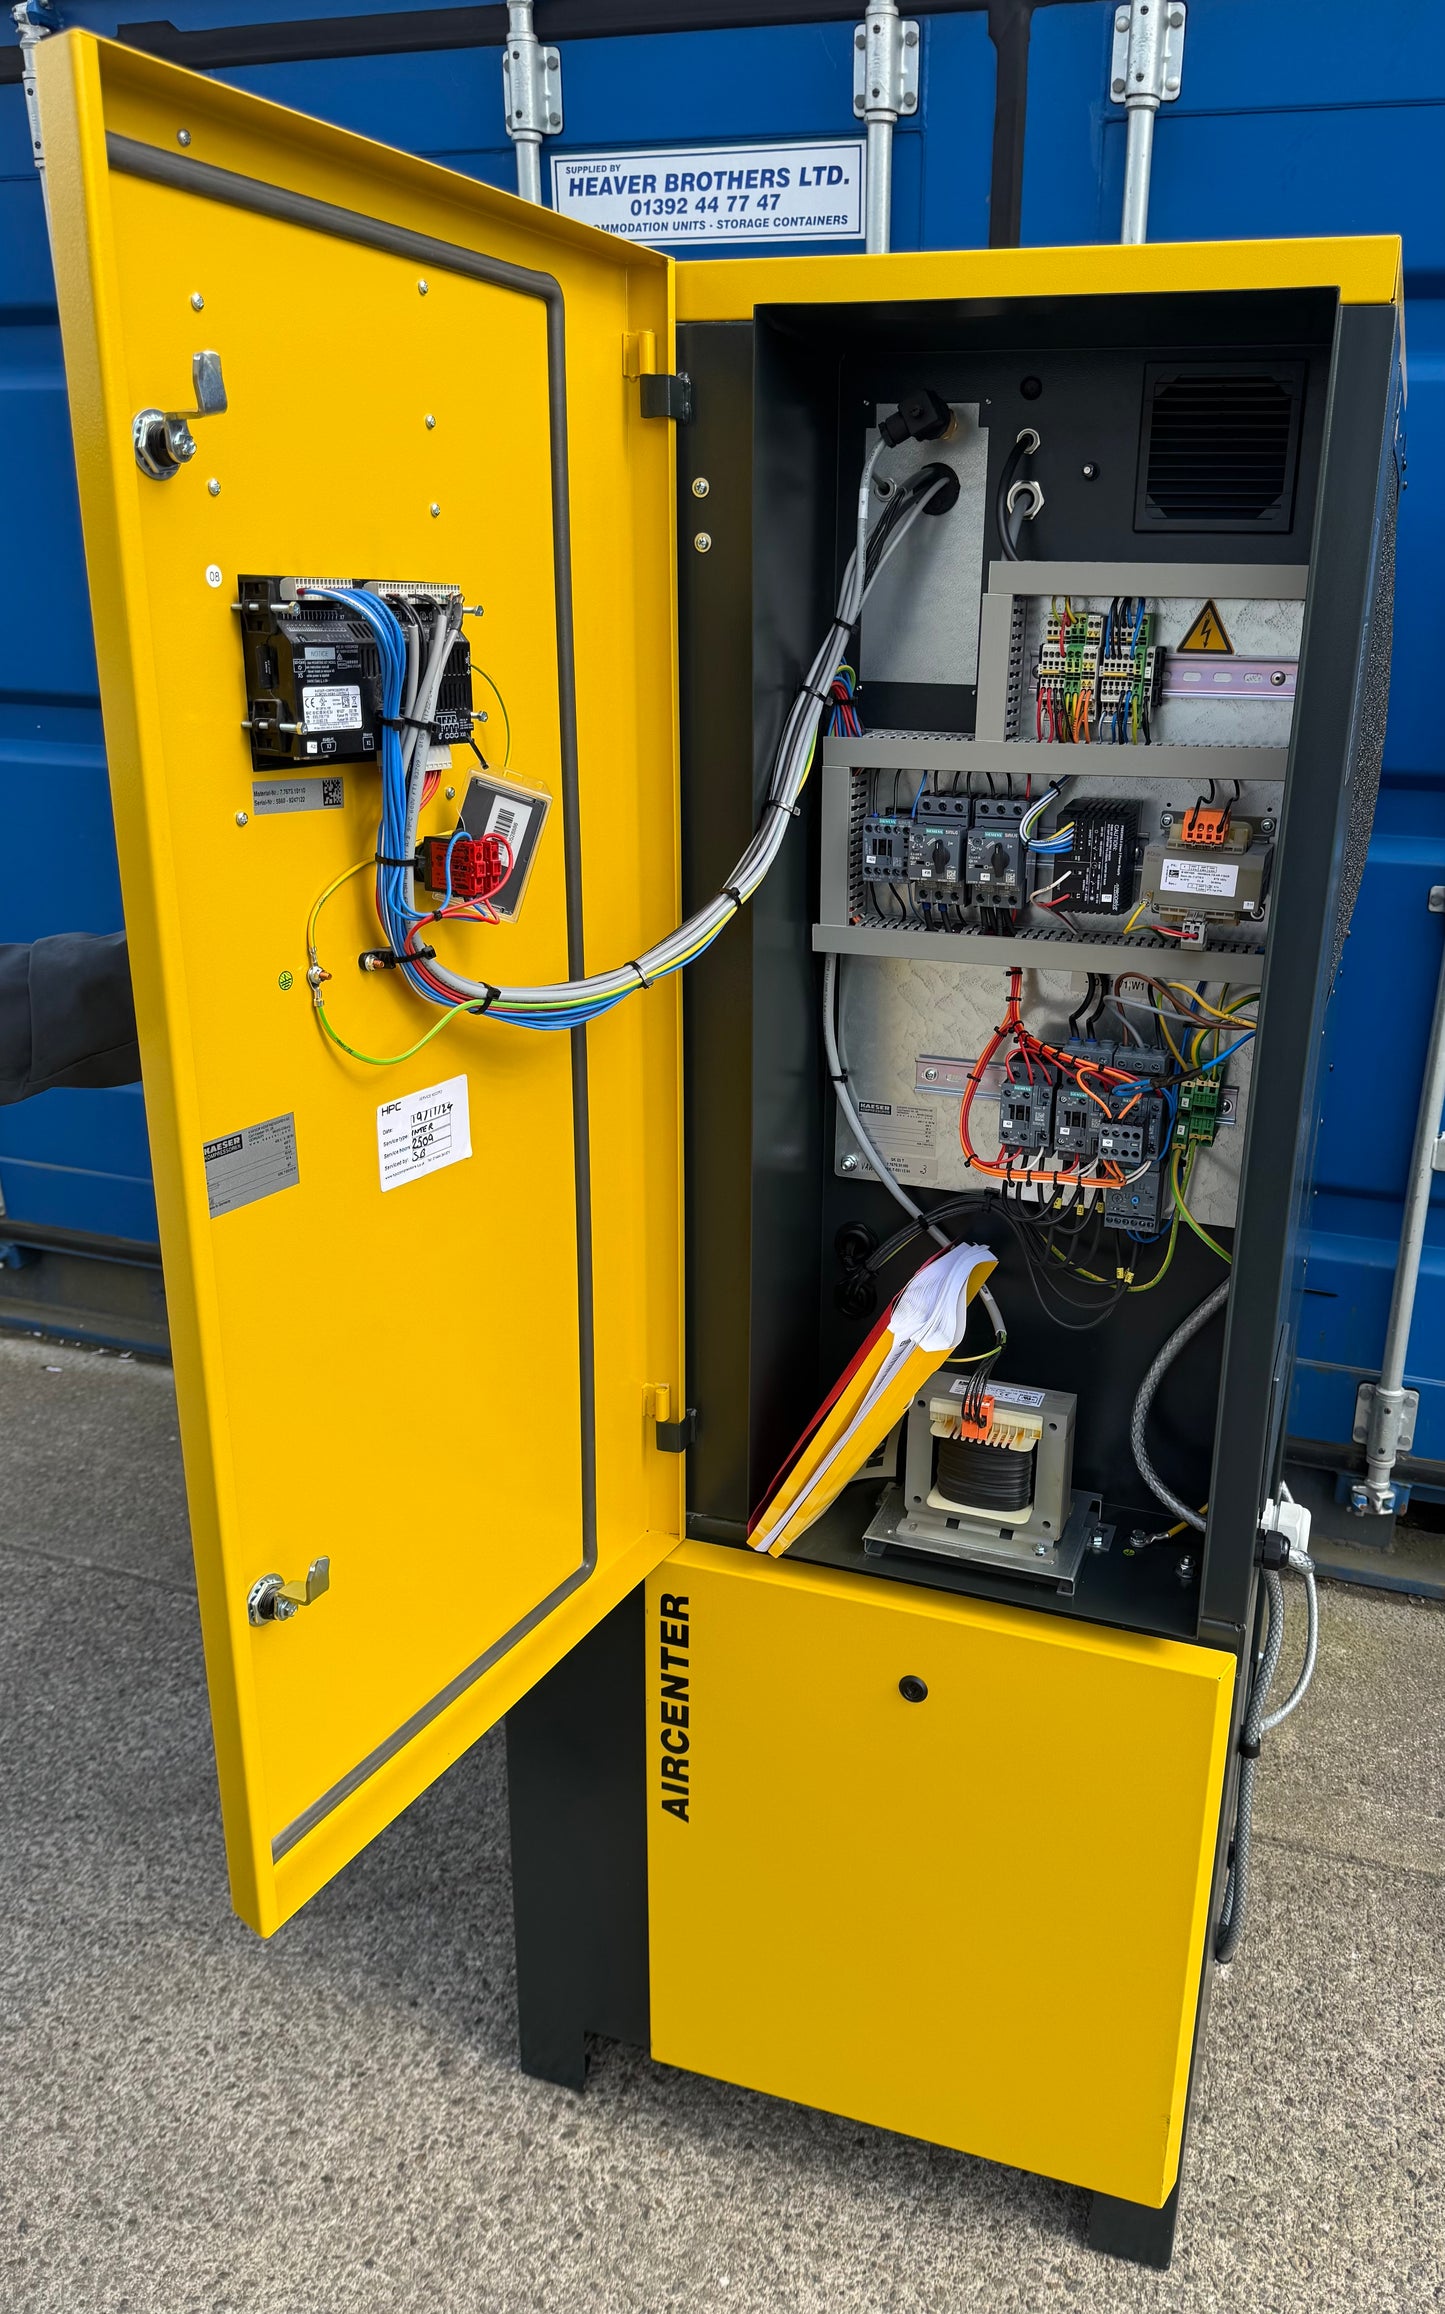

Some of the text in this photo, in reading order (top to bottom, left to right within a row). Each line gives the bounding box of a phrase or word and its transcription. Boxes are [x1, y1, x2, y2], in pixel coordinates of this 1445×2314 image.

[565, 164, 621, 175] SUPPLIED BY
[568, 165, 850, 197] HEAVER BROTHERS LTD.
[630, 193, 781, 216] 01392 44 77 47
[593, 214, 849, 234] MMODATION UNITS STORAGE CONTAINERS
[209, 571, 220, 582] 08
[381, 1102, 402, 1116] HPC
[204, 1136, 241, 1156] KAESER
[383, 1138, 399, 1147] Service
[383, 1149, 399, 1159] Service
[384, 1161, 402, 1171] Serviced
[660, 1592, 690, 1824] AIRCENTER
